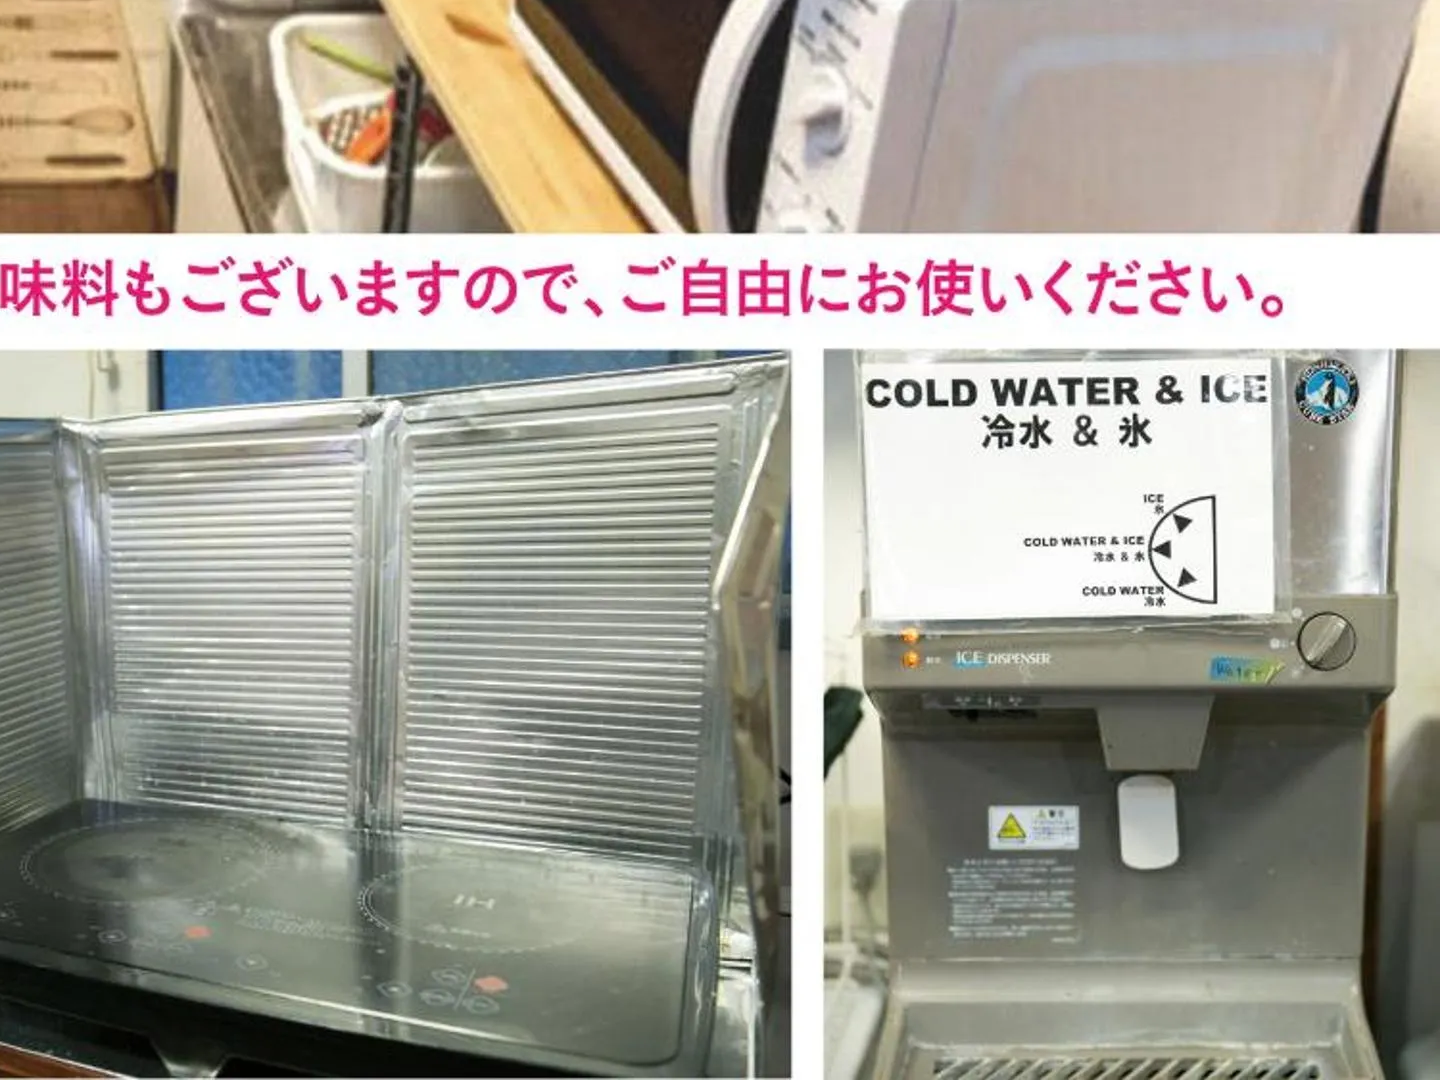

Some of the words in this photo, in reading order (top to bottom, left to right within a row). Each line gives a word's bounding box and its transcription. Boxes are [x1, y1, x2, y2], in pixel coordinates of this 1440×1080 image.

[865, 377, 979, 408] COLD
[990, 376, 1141, 407] WATER
[1154, 375, 1185, 405] &
[1200, 374, 1268, 403] ICE
[981, 413, 1053, 449] 冷水
[1072, 414, 1098, 447] &
[1118, 412, 1153, 449] 氷
[1143, 493, 1165, 503] ICE
[1023, 537, 1058, 547] COLD
[1061, 536, 1107, 547] WATER
[1123, 535, 1145, 545] ICE
[1082, 586, 1117, 597] COLD
[1119, 585, 1165, 596] WATER
[956, 650, 984, 665] ICE
[988, 652, 1052, 665] DISPENSER
